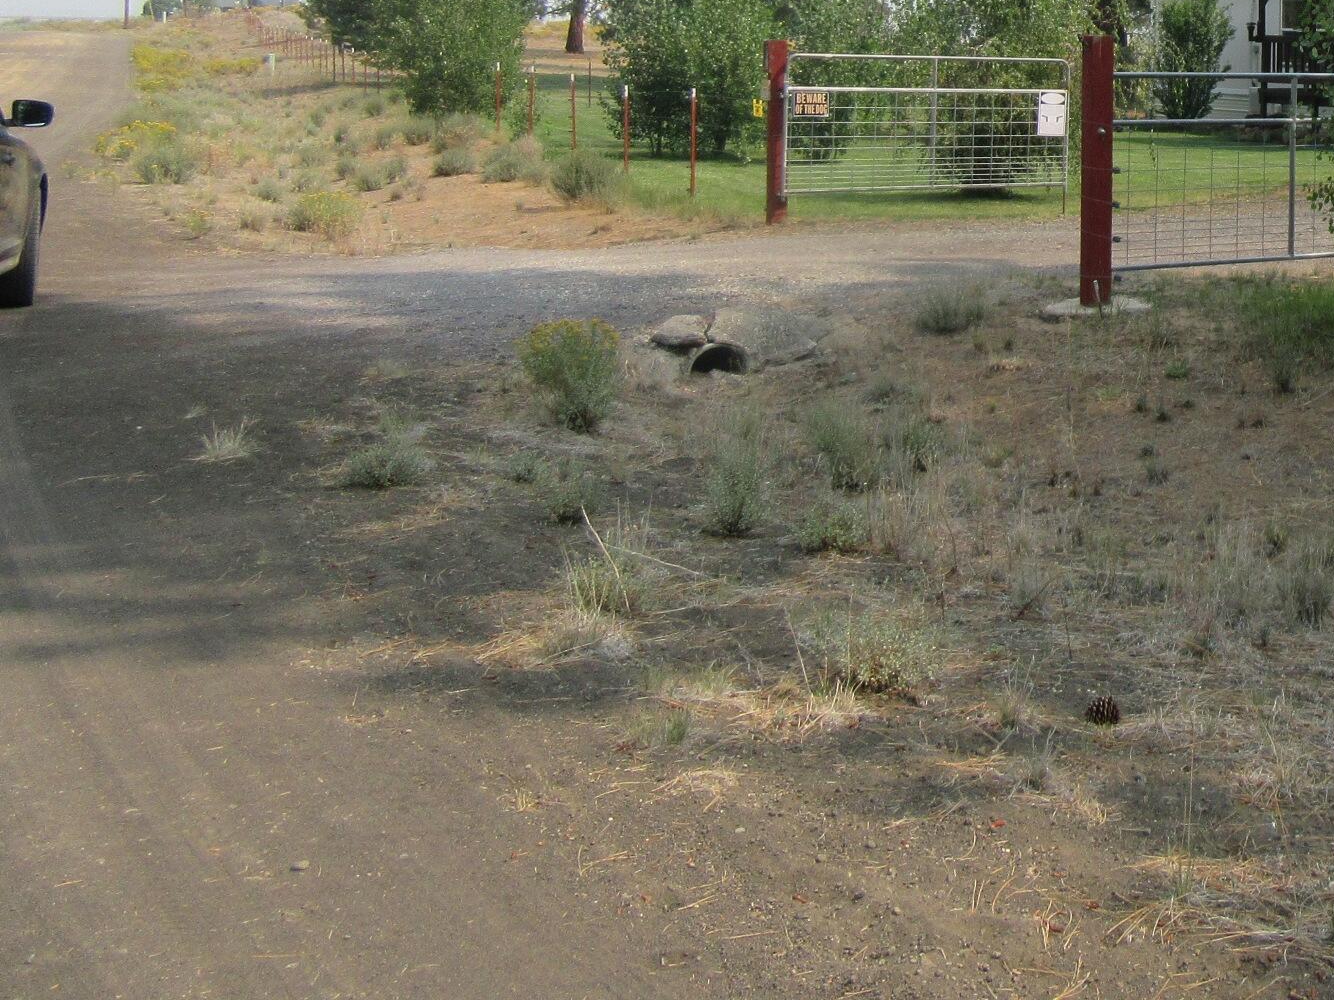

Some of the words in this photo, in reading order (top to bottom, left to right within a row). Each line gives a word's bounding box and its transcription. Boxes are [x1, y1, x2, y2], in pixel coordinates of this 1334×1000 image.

[796, 93, 826, 104] BEWARE
[796, 104, 803, 114] OF
[804, 104, 815, 114] THE
[816, 104, 828, 114] DOG
